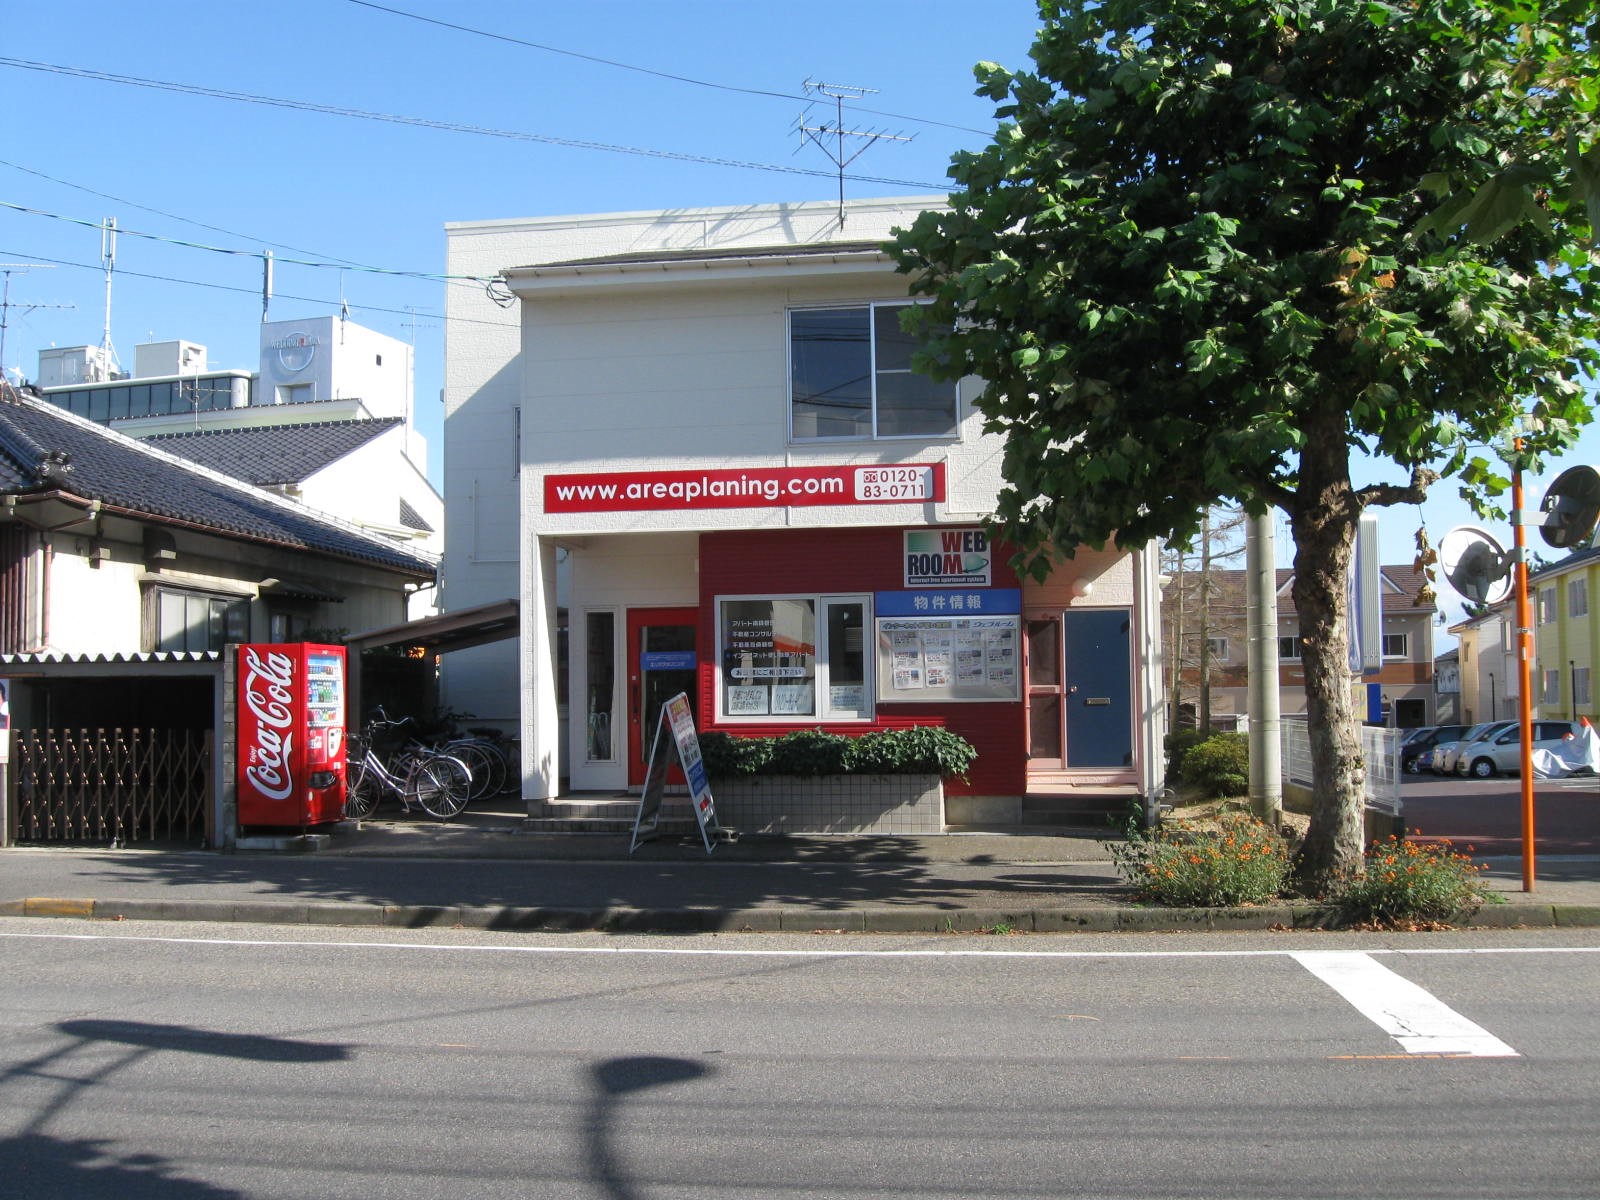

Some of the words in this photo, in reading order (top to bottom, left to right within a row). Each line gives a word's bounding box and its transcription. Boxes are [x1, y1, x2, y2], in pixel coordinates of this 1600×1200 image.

[880, 470, 925, 483] 0120-
[556, 475, 844, 502] www.areaplaning.com
[863, 485, 924, 498] 83-0711
[941, 531, 987, 553] WEB
[908, 553, 963, 575] ROOM
[914, 595, 982, 610] 物件情報
[246, 647, 294, 800] Coca-Cola
